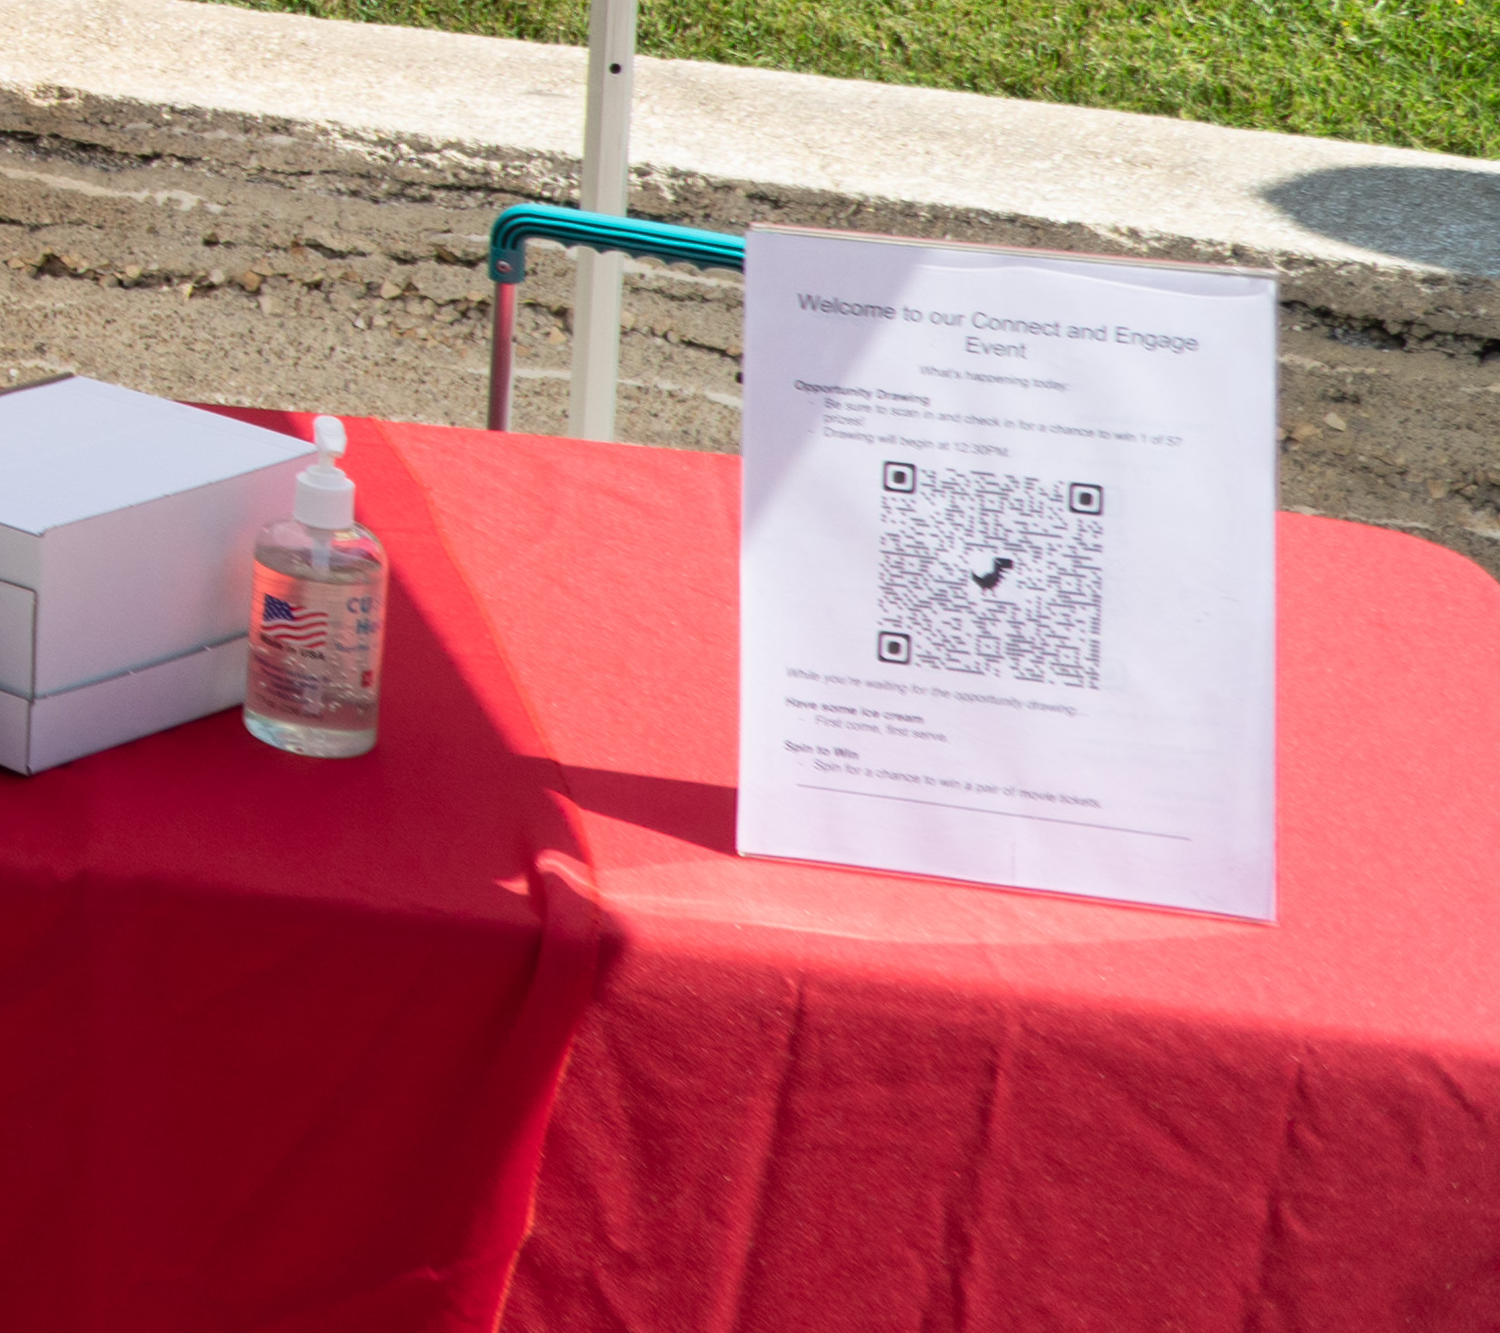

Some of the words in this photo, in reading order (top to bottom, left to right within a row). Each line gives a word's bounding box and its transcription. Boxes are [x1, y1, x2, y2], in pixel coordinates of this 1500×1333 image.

[796, 292, 897, 321] Welcome
[902, 305, 924, 324] to
[928, 310, 965, 328] our
[970, 310, 1062, 338] Connect
[1066, 321, 1108, 343] and
[1113, 325, 1199, 358] Engage
[964, 334, 1028, 359] Event
[793, 378, 872, 400] Opportunity
[875, 387, 931, 406] Drawing
